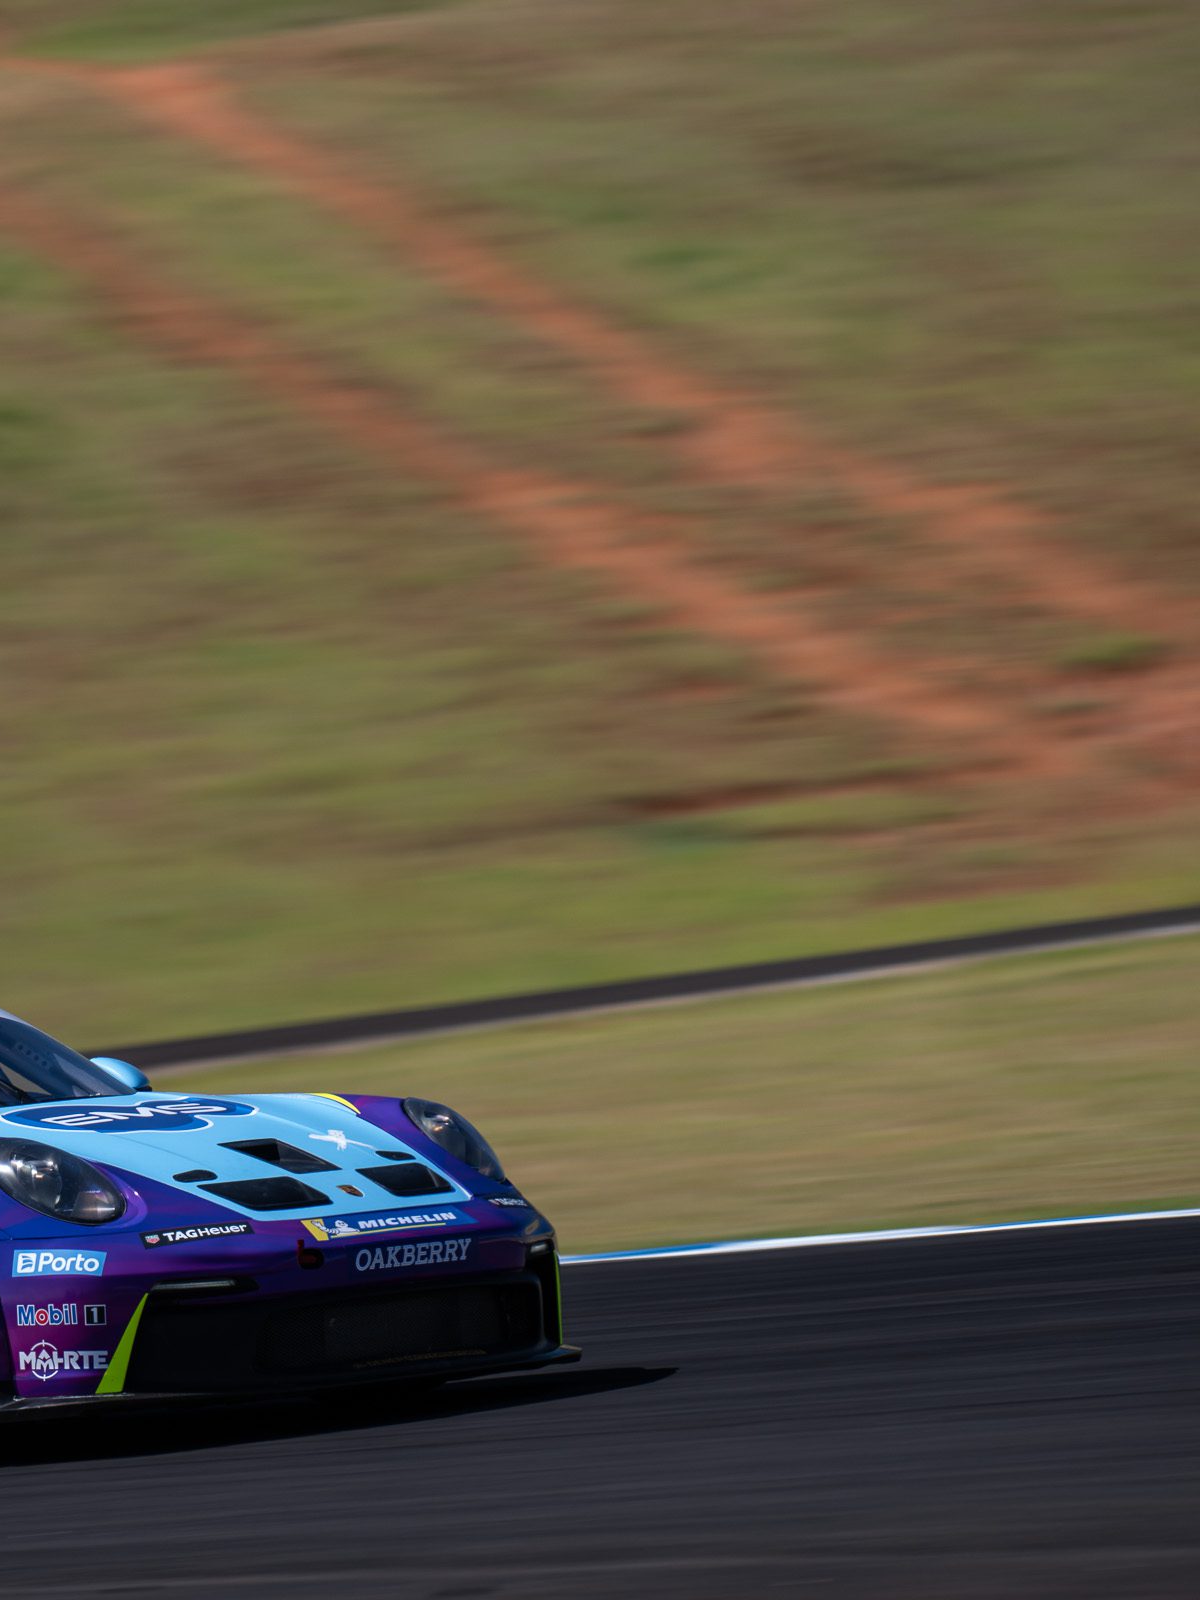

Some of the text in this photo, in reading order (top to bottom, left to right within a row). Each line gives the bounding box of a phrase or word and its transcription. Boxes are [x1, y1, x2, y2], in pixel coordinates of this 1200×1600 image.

[40, 1103, 227, 1127] EMS
[358, 1212, 457, 1230] MICHELIN
[37, 1253, 100, 1273] Porto
[355, 1238, 472, 1271] OAKBERRY
[16, 1303, 78, 1326] Mobil
